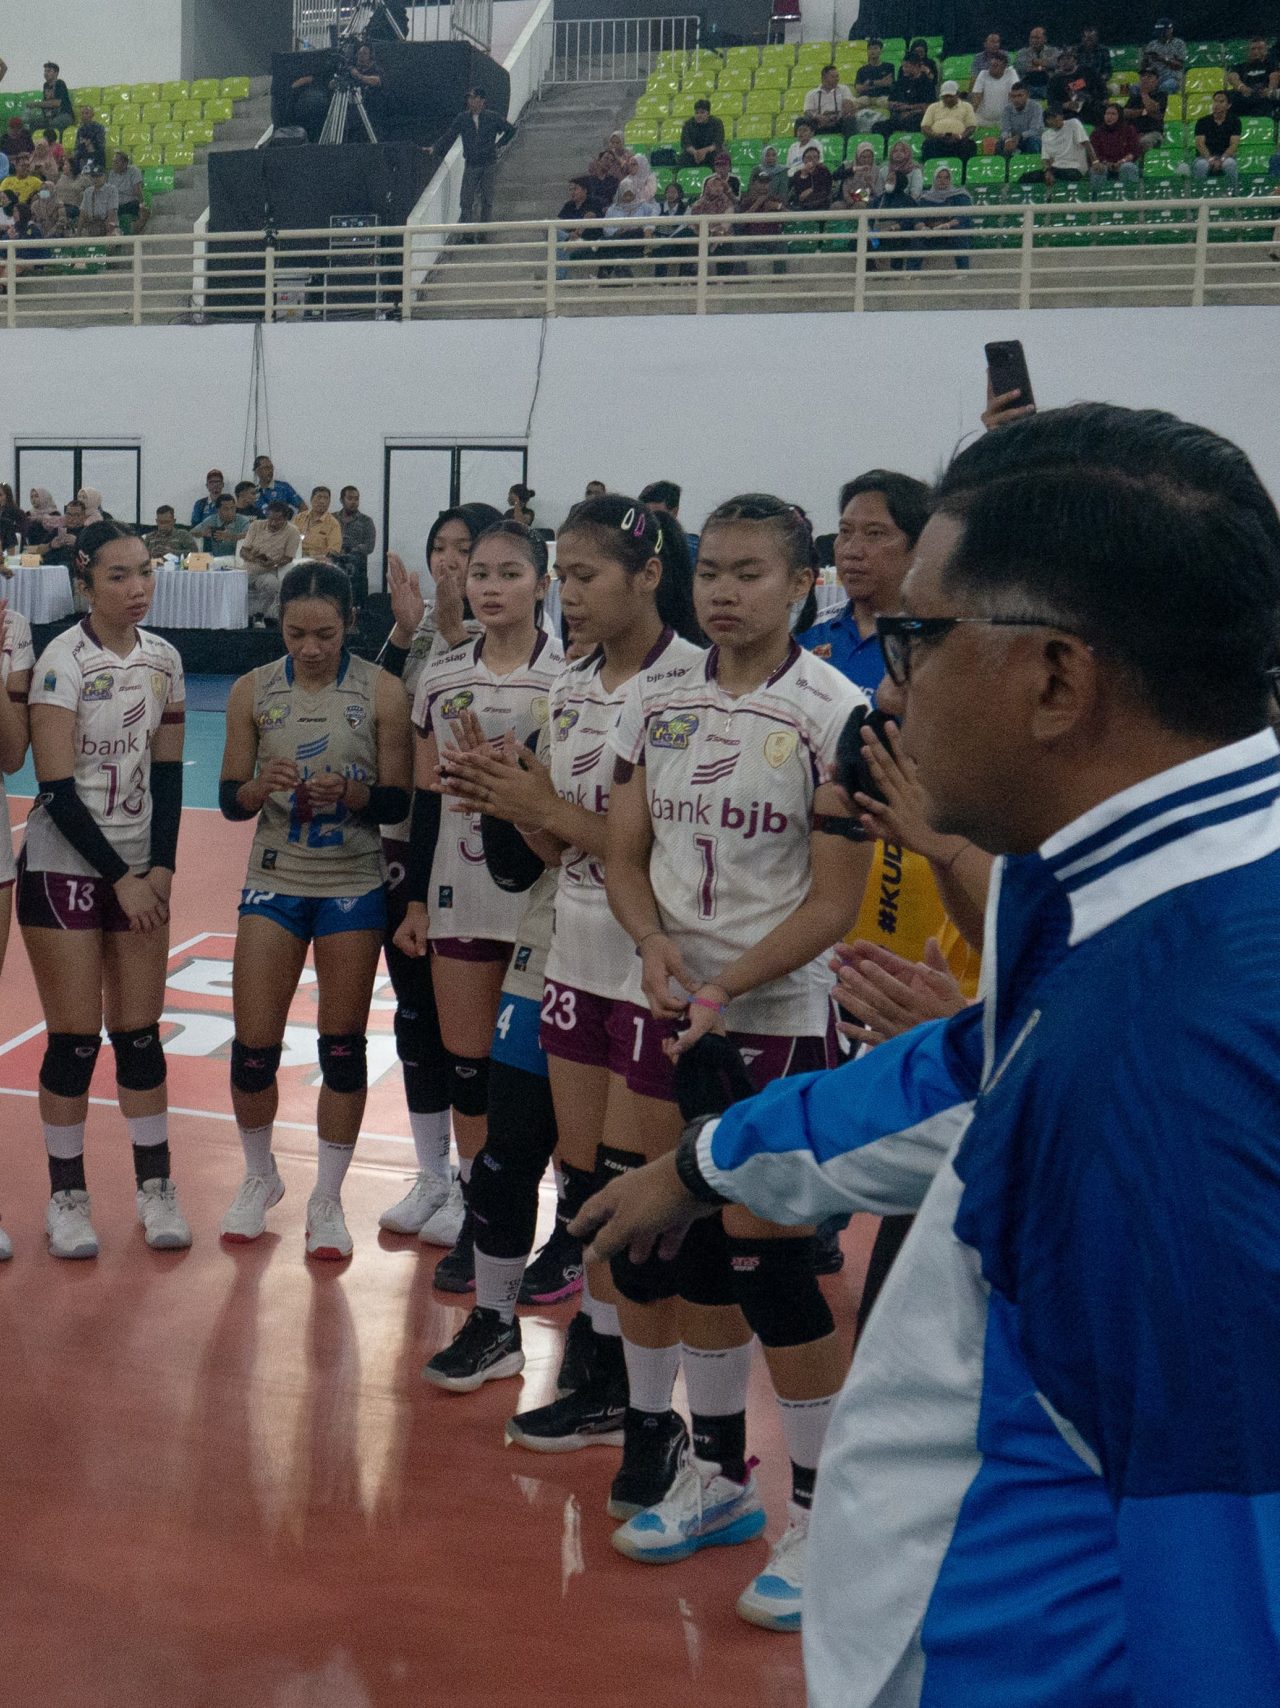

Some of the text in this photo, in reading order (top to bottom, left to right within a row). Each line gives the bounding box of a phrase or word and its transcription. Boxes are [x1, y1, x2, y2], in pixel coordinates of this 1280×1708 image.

[445, 652, 467, 664] siap
[646, 667, 693, 684] bjb sia
[81, 731, 140, 756] bank
[99, 763, 147, 819] 13
[652, 789, 712, 825] bank
[720, 797, 788, 839] bjb
[66, 880, 96, 912] 13
[694, 833, 718, 922] 1
[496, 1004, 514, 1040] 4
[540, 983, 577, 1031] 23
[632, 1016, 644, 1062] 1
